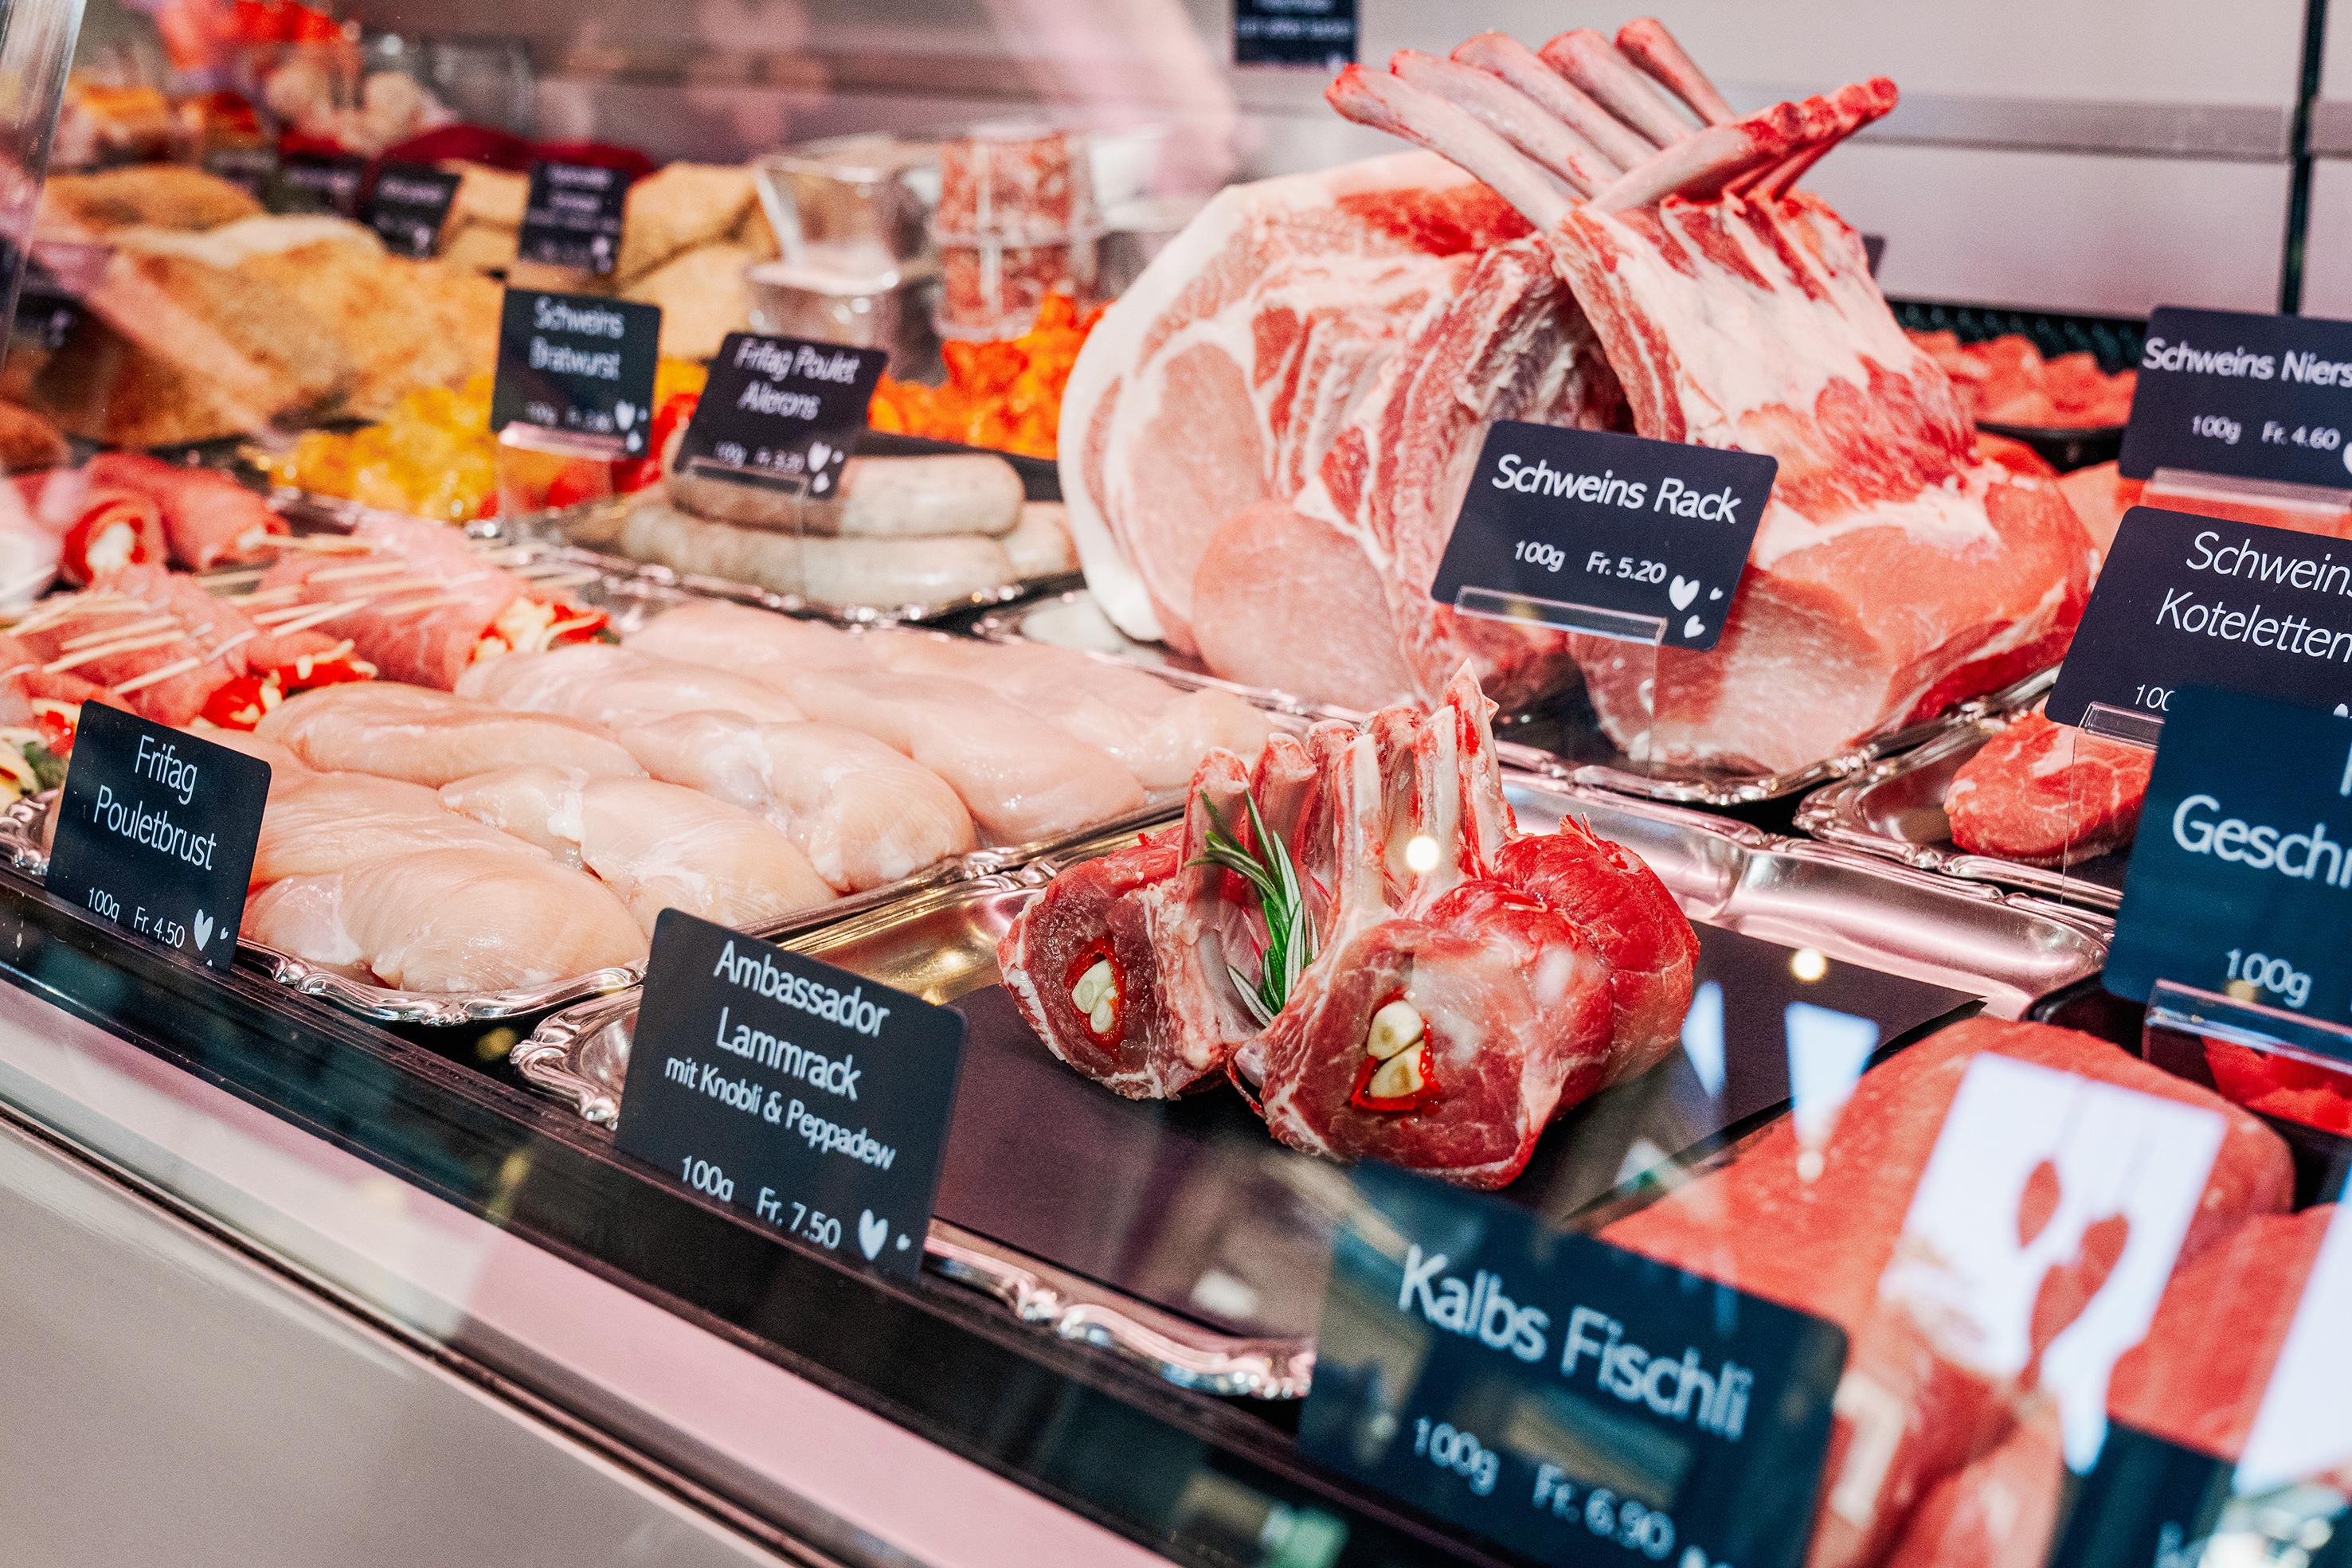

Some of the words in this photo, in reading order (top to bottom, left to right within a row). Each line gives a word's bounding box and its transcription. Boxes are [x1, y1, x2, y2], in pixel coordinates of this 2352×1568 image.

[790, 345, 860, 384] Poulet
[2142, 336, 2276, 380] Schweins
[2192, 414, 2241, 444] 100g
[2261, 420, 2287, 445] Fr.
[2291, 424, 2341, 451] 4.60
[1492, 454, 1647, 510] Schweins
[1653, 476, 1742, 524] Rack
[1515, 540, 1566, 572] 100g
[1586, 551, 1612, 576] Fr.
[1615, 557, 1667, 584] 5.20
[2186, 530, 2352, 597] Schwein
[2155, 587, 2352, 663] Koteletten
[135, 733, 198, 805] Frifag
[93, 784, 217, 870] Pouletbrust
[88, 887, 120, 923] 100g
[134, 905, 149, 934] Fr.
[154, 917, 186, 948] 4.50
[714, 940, 890, 1037] Ambassador
[2226, 948, 2312, 1009] 100g
[716, 1006, 861, 1101] Lammrack
[664, 1056, 698, 1089] mit
[699, 1064, 763, 1115] Knobli
[763, 1090, 783, 1125] &
[785, 1099, 898, 1171] Peppadew
[681, 1155, 734, 1202] 100g
[756, 1187, 783, 1226] Fr.
[791, 1202, 842, 1250] 7.50
[1397, 1243, 1551, 1363] Kalbs
[1559, 1304, 1754, 1442] Fischli
[1414, 1417, 1500, 1496] 100g
[1532, 1464, 1581, 1524] Fr.
[1584, 1488, 1677, 1562] 6.90
